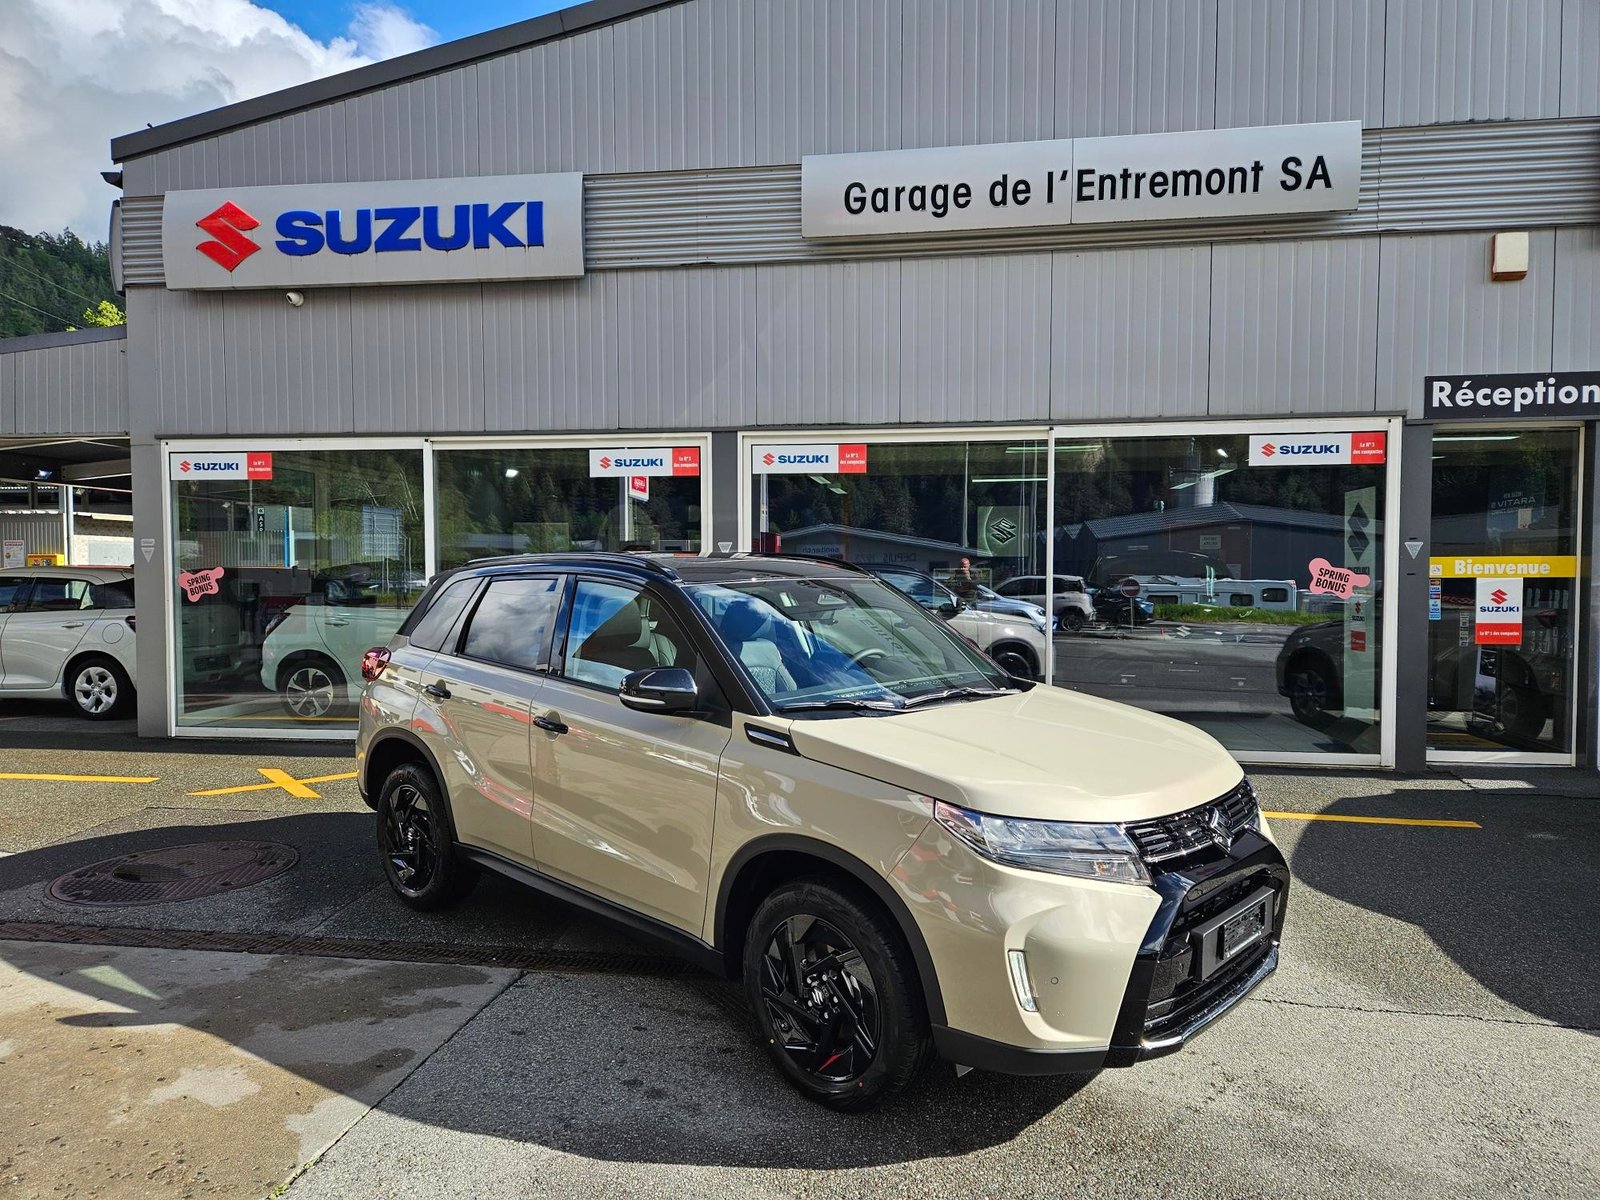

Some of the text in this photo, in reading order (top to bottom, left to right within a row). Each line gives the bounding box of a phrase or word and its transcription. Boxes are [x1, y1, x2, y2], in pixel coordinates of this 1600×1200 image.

[844, 156, 1333, 218] Garage de l'Entremont SA
[275, 201, 544, 256] SUZUKI
[1432, 377, 1600, 412] Réception
[1279, 444, 1340, 455] SUZUKI
[193, 462, 239, 471] SUZUKI
[614, 458, 664, 467] SUZUKI
[778, 454, 829, 464] SUZUKI
[1454, 559, 1550, 575] Bienvenue
[187, 573, 211, 587] SPRING
[1318, 567, 1350, 583] SPRING
[189, 582, 213, 596] BONUS
[1315, 577, 1347, 593] BONUS
